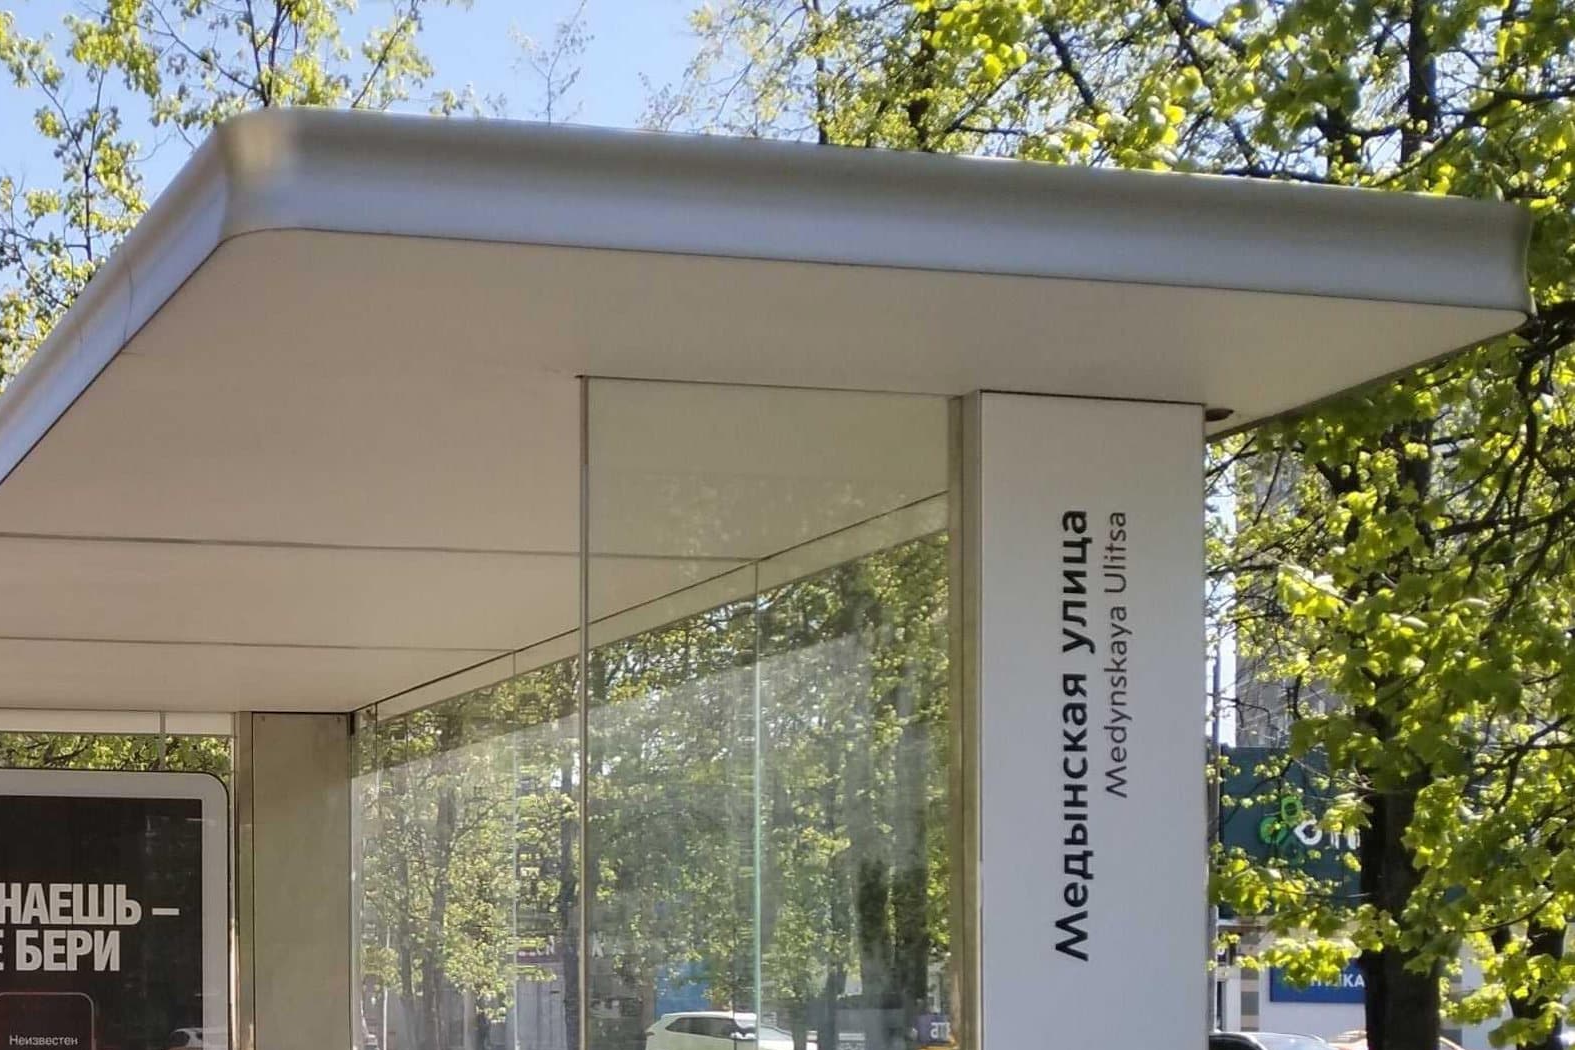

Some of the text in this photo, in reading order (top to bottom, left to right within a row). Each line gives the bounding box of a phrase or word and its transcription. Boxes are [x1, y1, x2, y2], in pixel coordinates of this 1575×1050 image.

[1055, 510, 1095, 962] Медынская улица
[1103, 512, 1133, 798] Medynskaya Ulitsa
[15, 929, 121, 972] БЕРИ
[9, 1034, 78, 1046] Неизвестен
